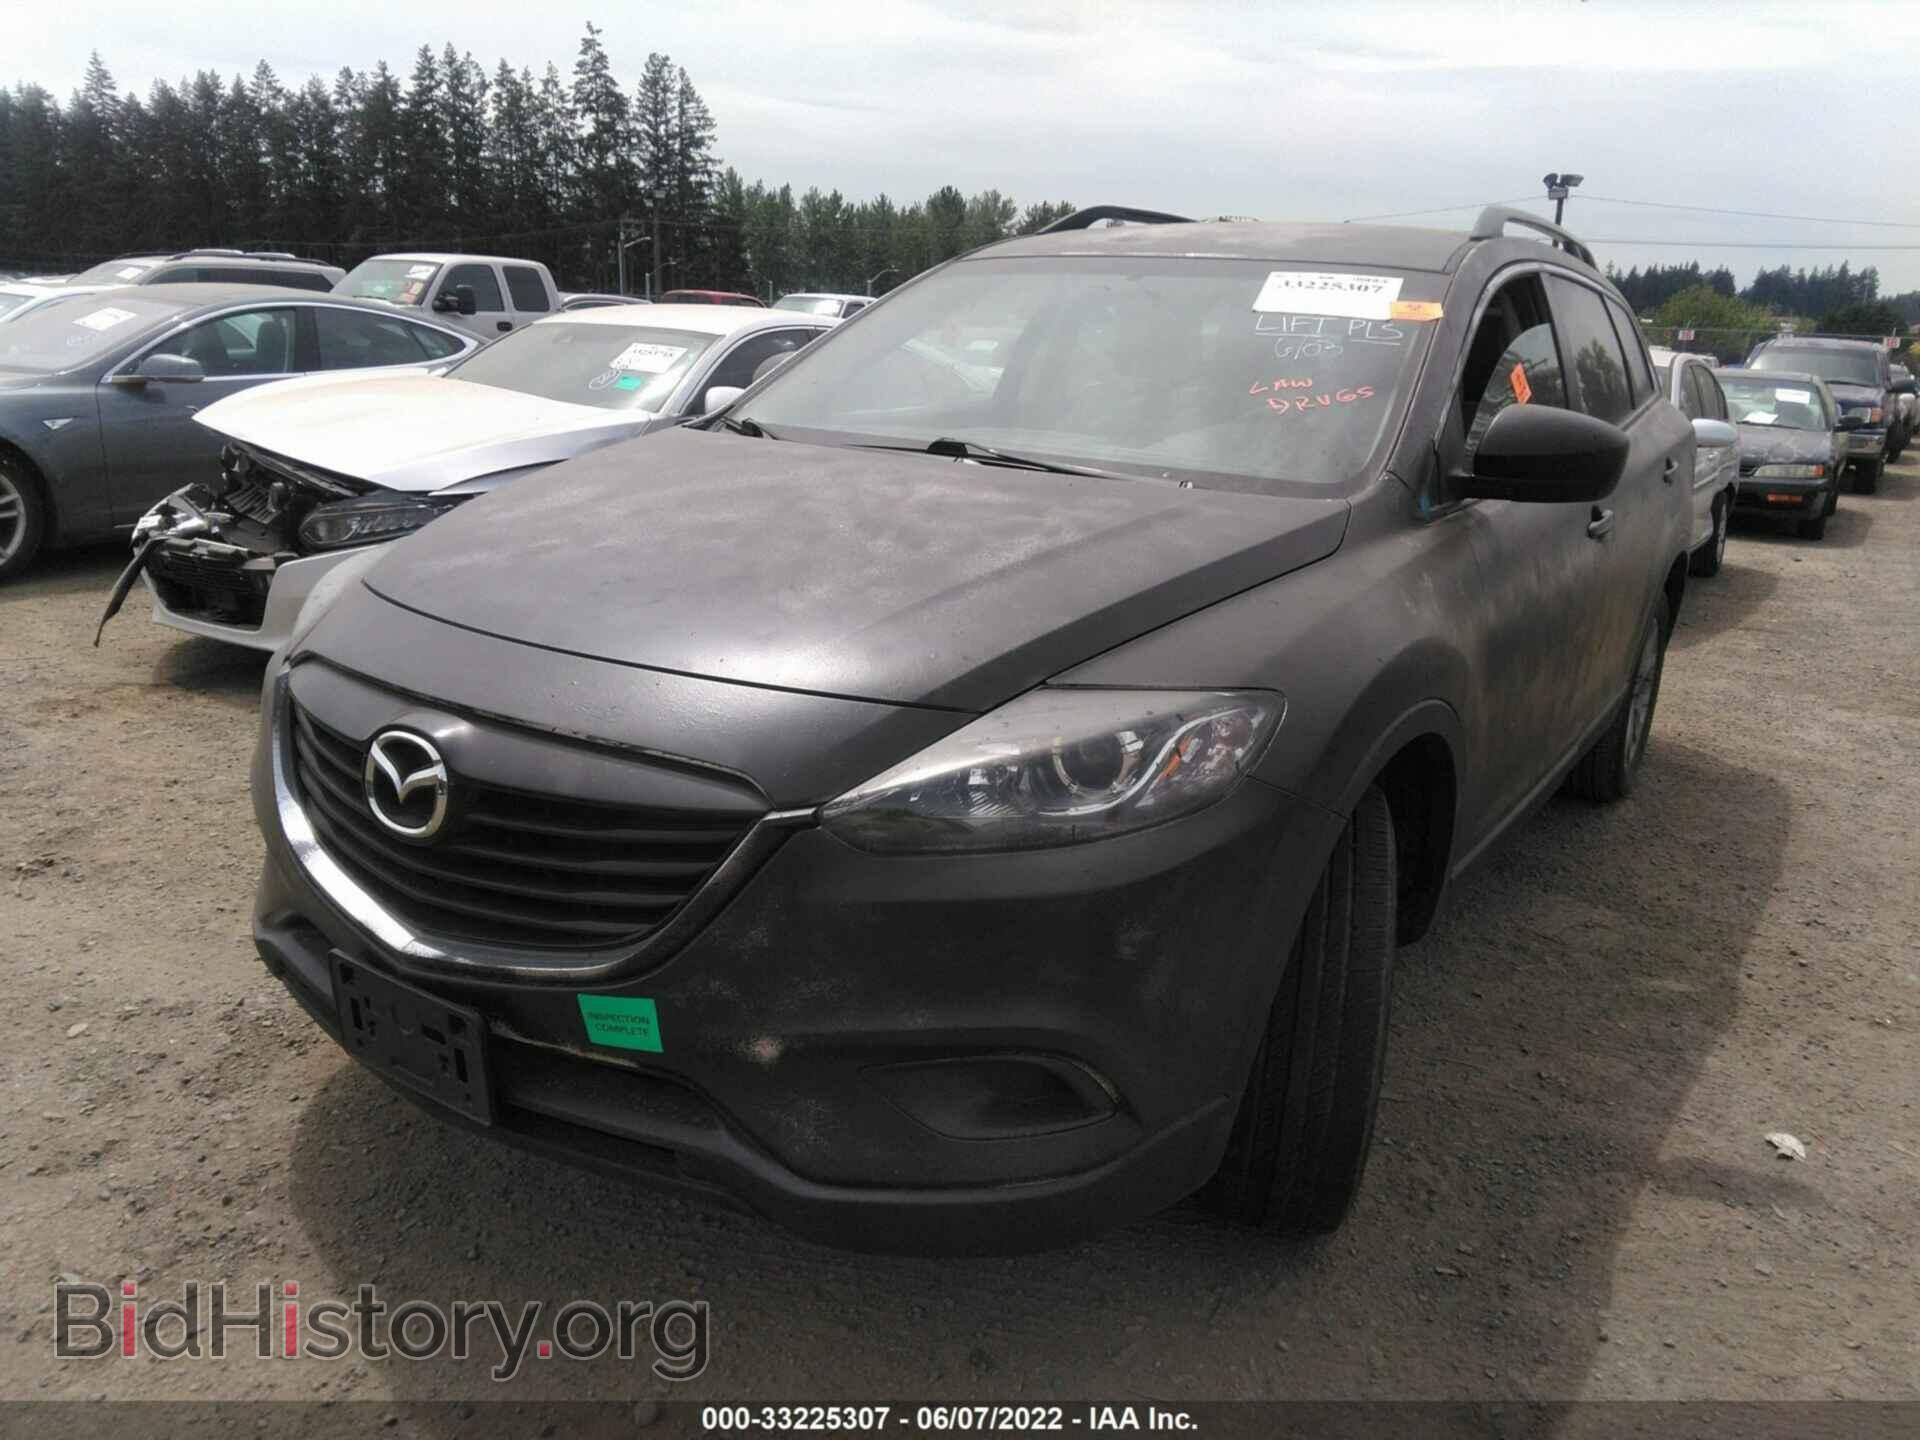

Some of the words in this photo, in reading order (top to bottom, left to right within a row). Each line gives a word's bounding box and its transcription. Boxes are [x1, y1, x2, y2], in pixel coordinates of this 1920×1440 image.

[1255, 313, 1339, 334] LIFT
[1347, 319, 1404, 339] PLS
[1266, 386, 1375, 414] DRUGS
[583, 1012, 649, 1024] INSPECTION
[595, 1024, 649, 1037] COMPLETE
